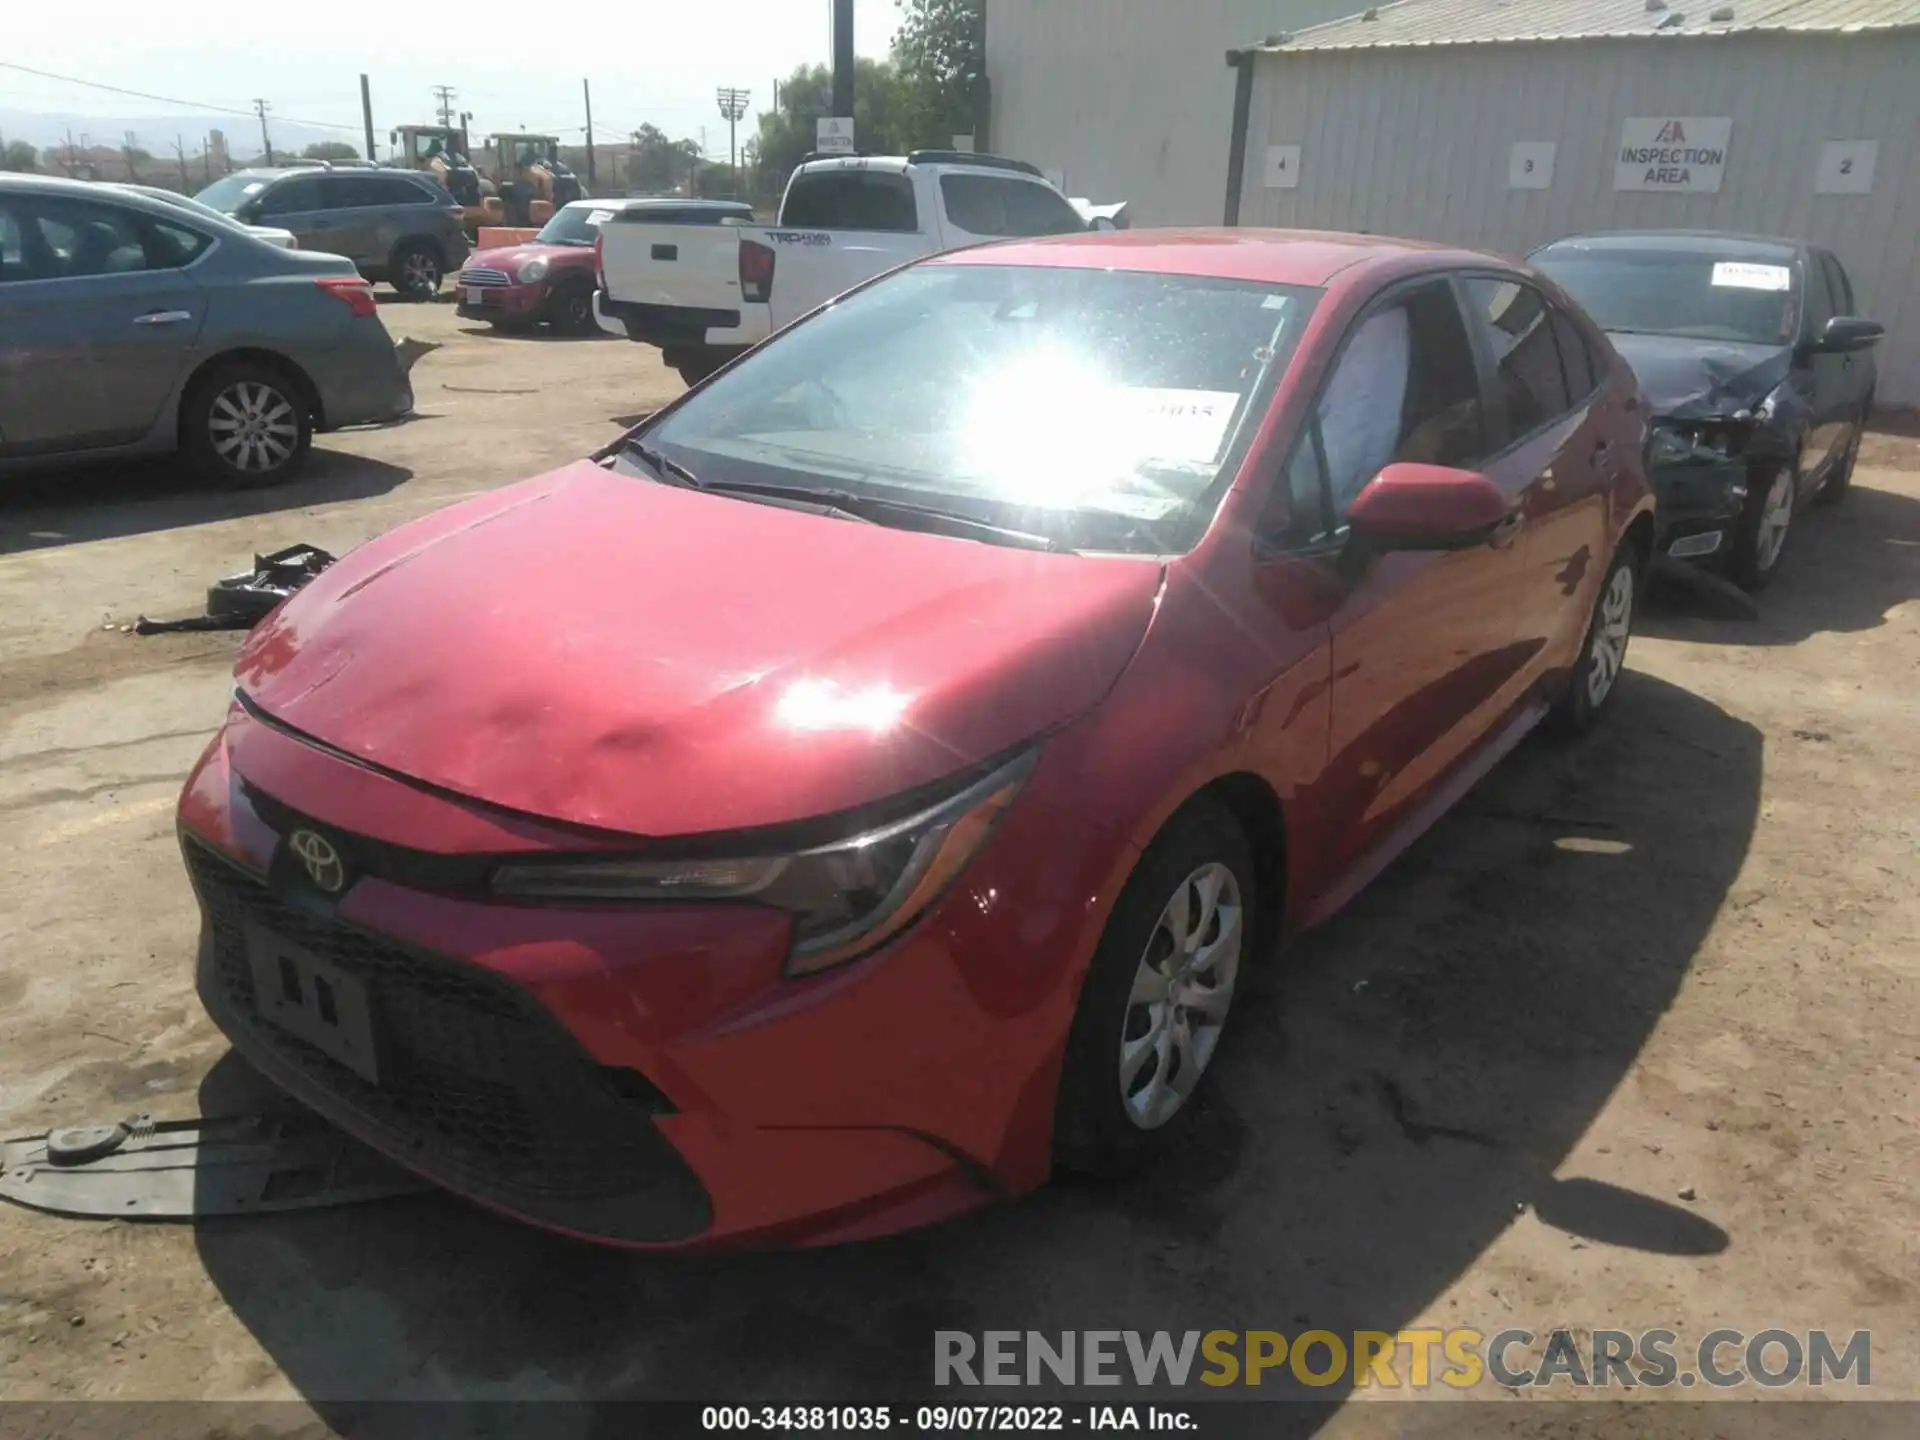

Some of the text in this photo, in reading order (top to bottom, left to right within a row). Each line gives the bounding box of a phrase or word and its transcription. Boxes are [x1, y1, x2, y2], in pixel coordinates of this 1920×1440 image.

[1278, 156, 1286, 171] 4
[1622, 148, 1723, 164] INSPECTION
[1525, 159, 1534, 172] 3
[1840, 158, 1852, 175] 2
[1644, 168, 1690, 183] AREA
